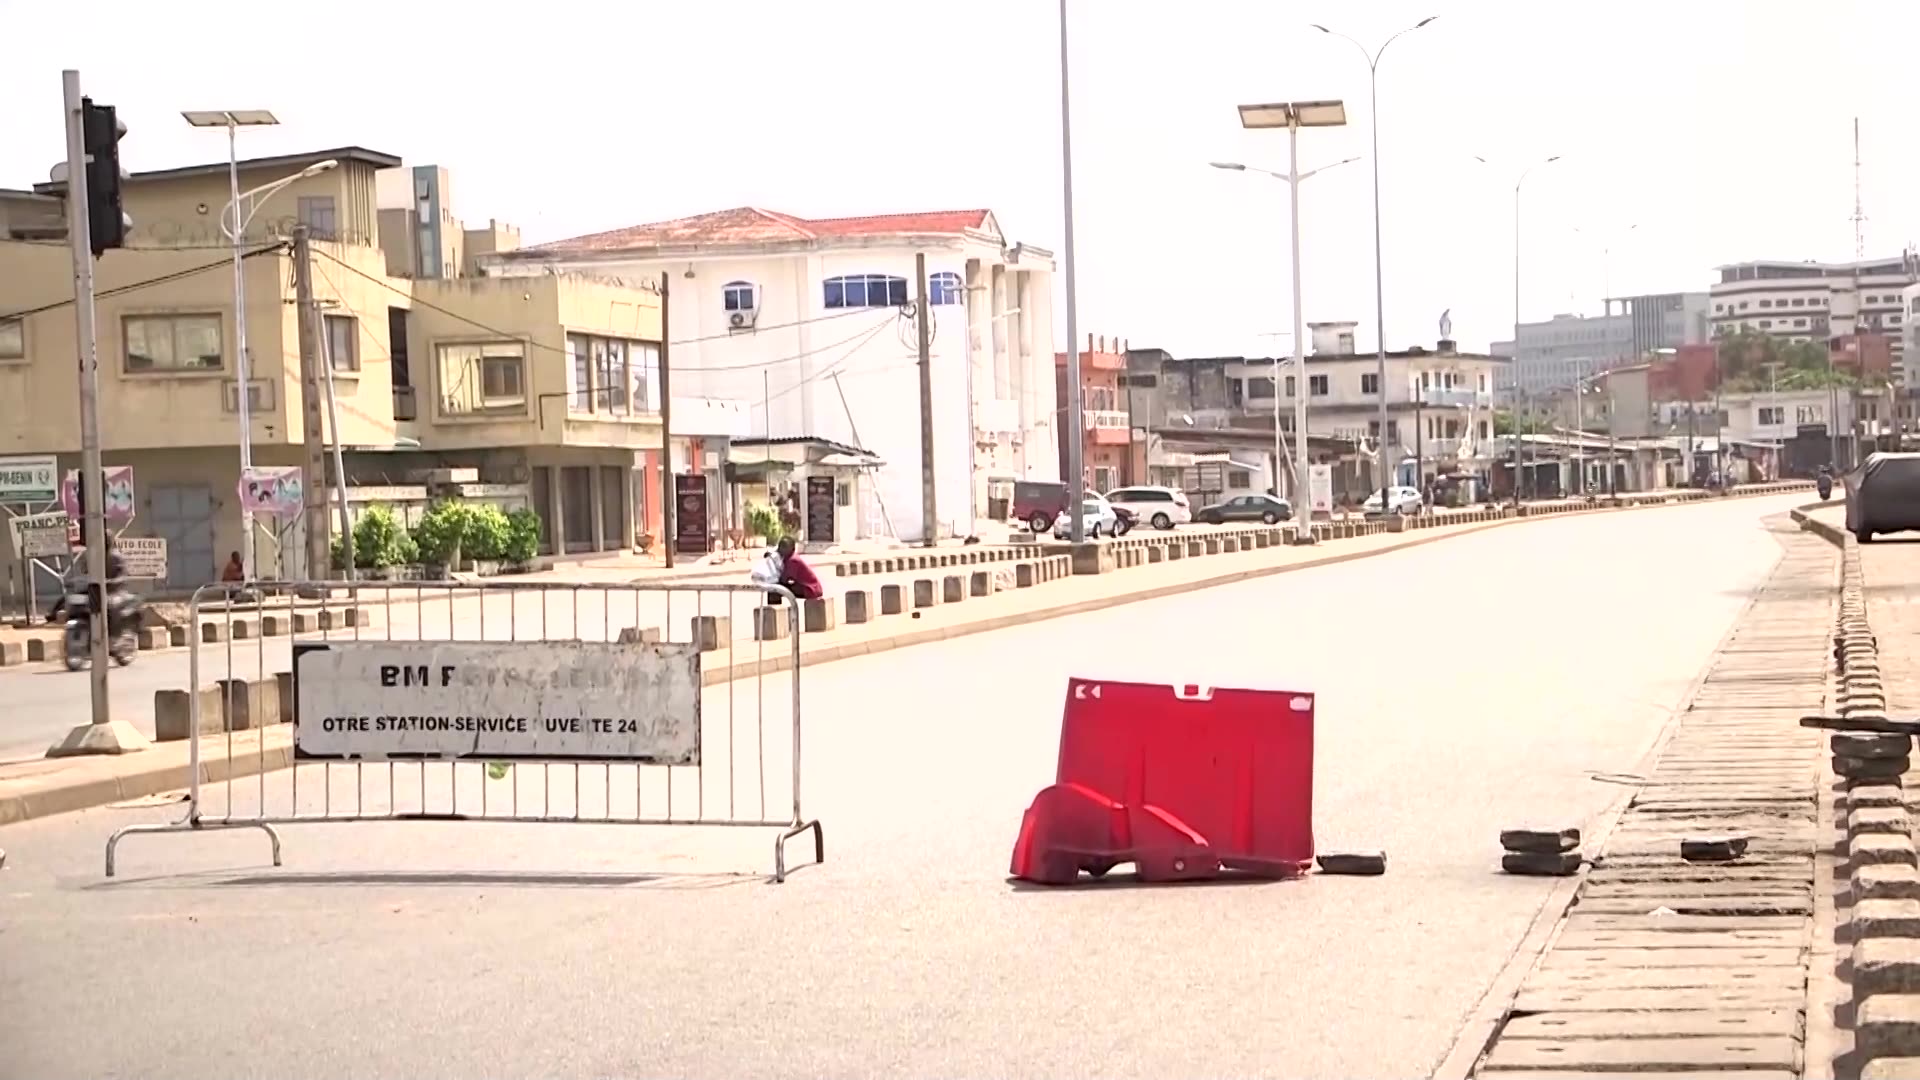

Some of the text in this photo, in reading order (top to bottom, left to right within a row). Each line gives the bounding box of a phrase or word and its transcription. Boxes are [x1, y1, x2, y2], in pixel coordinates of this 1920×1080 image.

[113, 540, 161, 549] AUTO ECOLE
[375, 714, 528, 734] STATION-SERVICE
